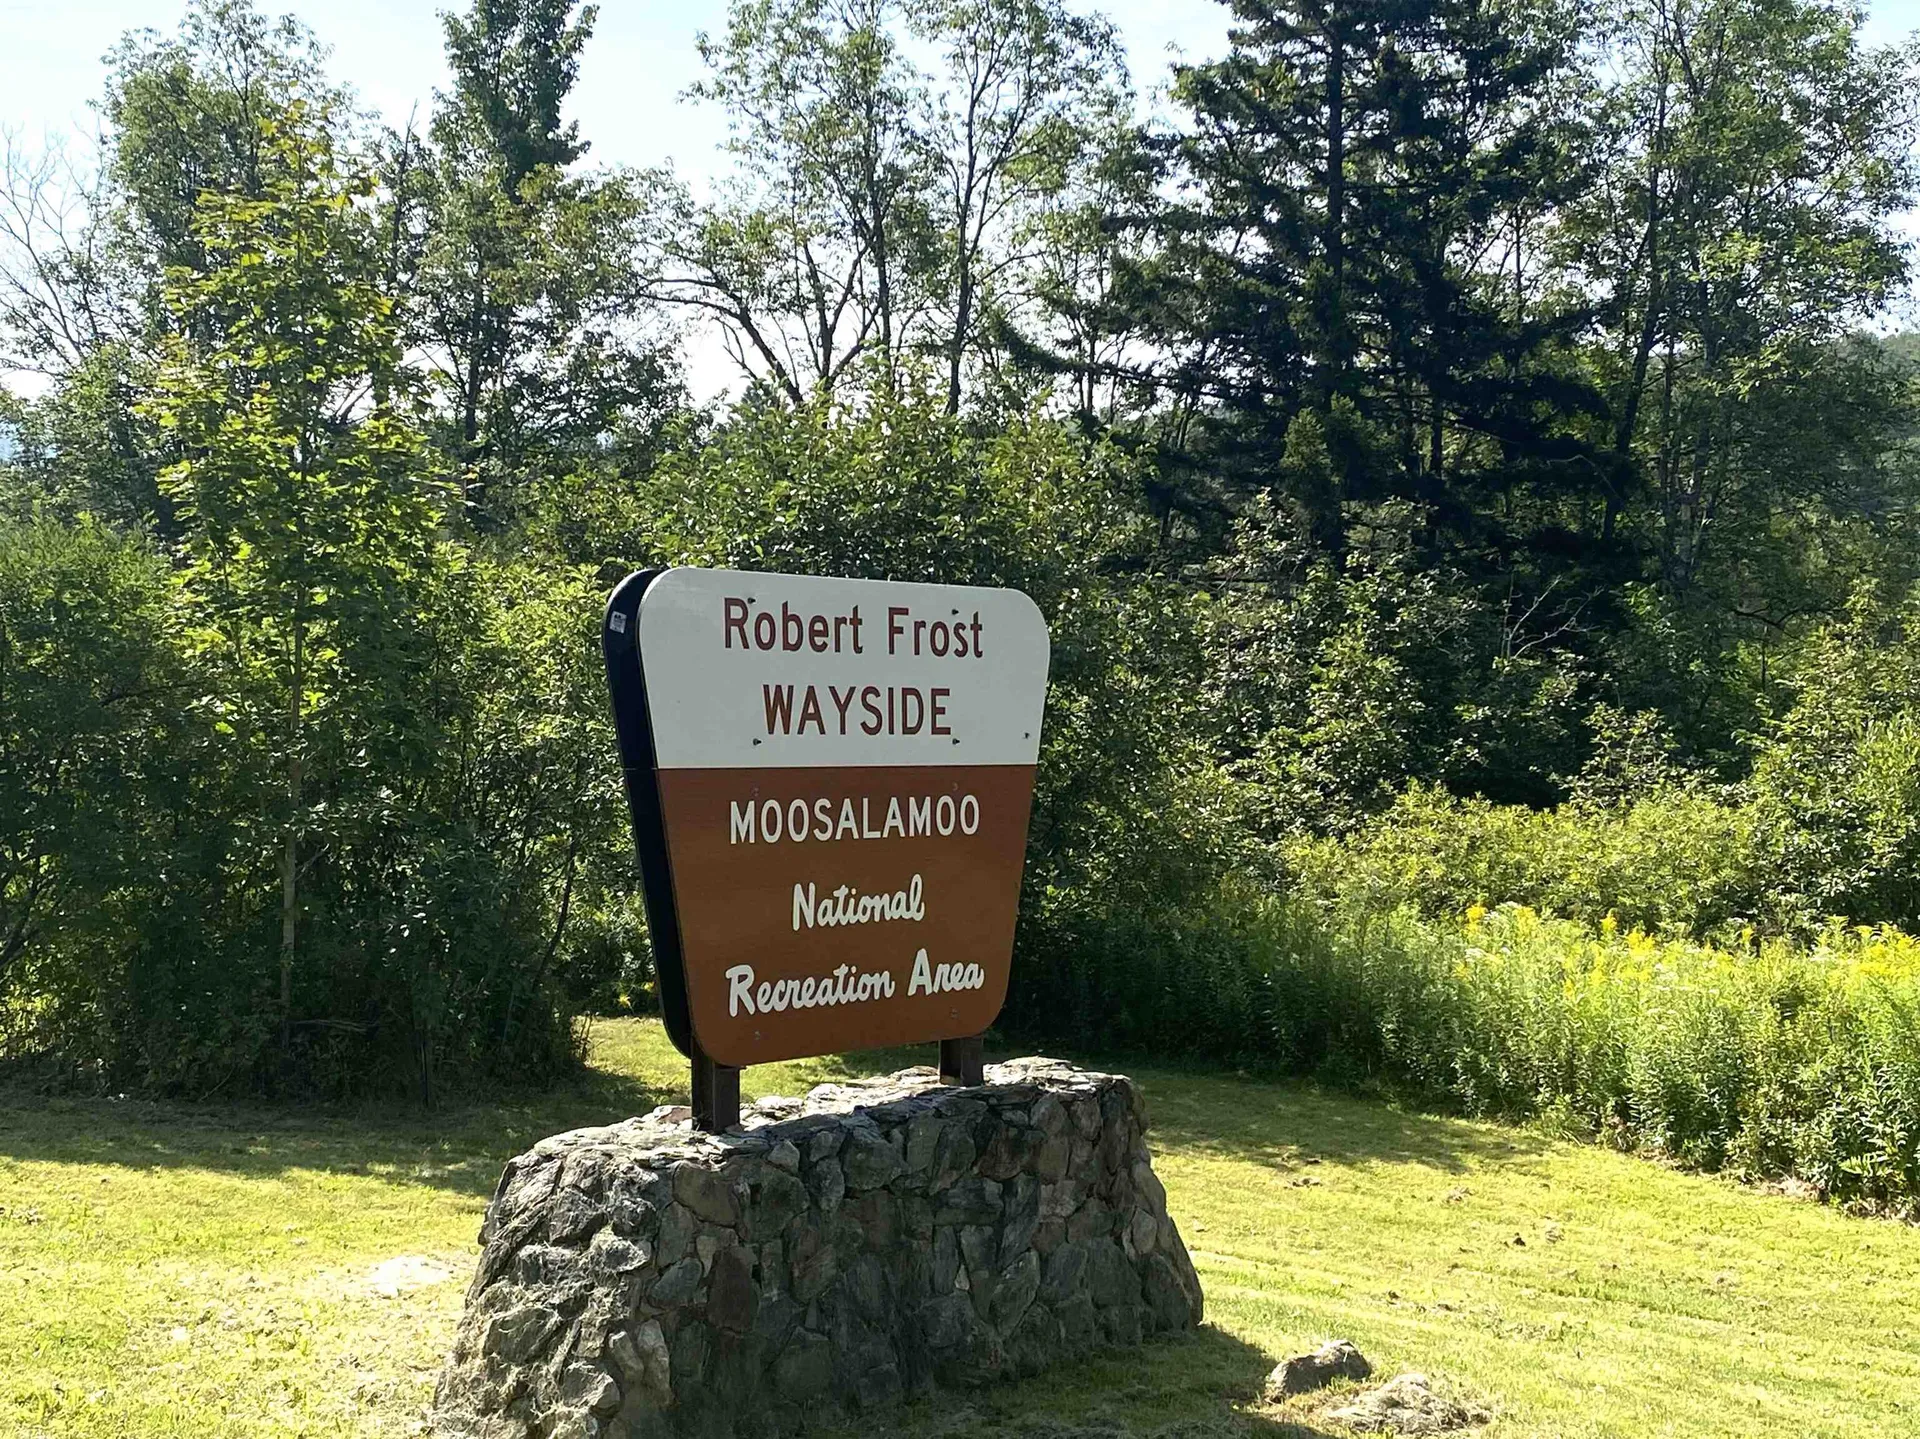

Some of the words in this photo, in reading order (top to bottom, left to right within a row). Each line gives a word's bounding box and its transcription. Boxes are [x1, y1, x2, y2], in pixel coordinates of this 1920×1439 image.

[724, 597, 863, 655] Robert
[888, 607, 983, 658] Frost
[763, 684, 951, 736] WAYSIDE
[730, 794, 980, 844] MOOSALAMOO
[792, 873, 925, 931] National
[725, 963, 895, 1017] Recreation
[908, 948, 984, 996] Area
